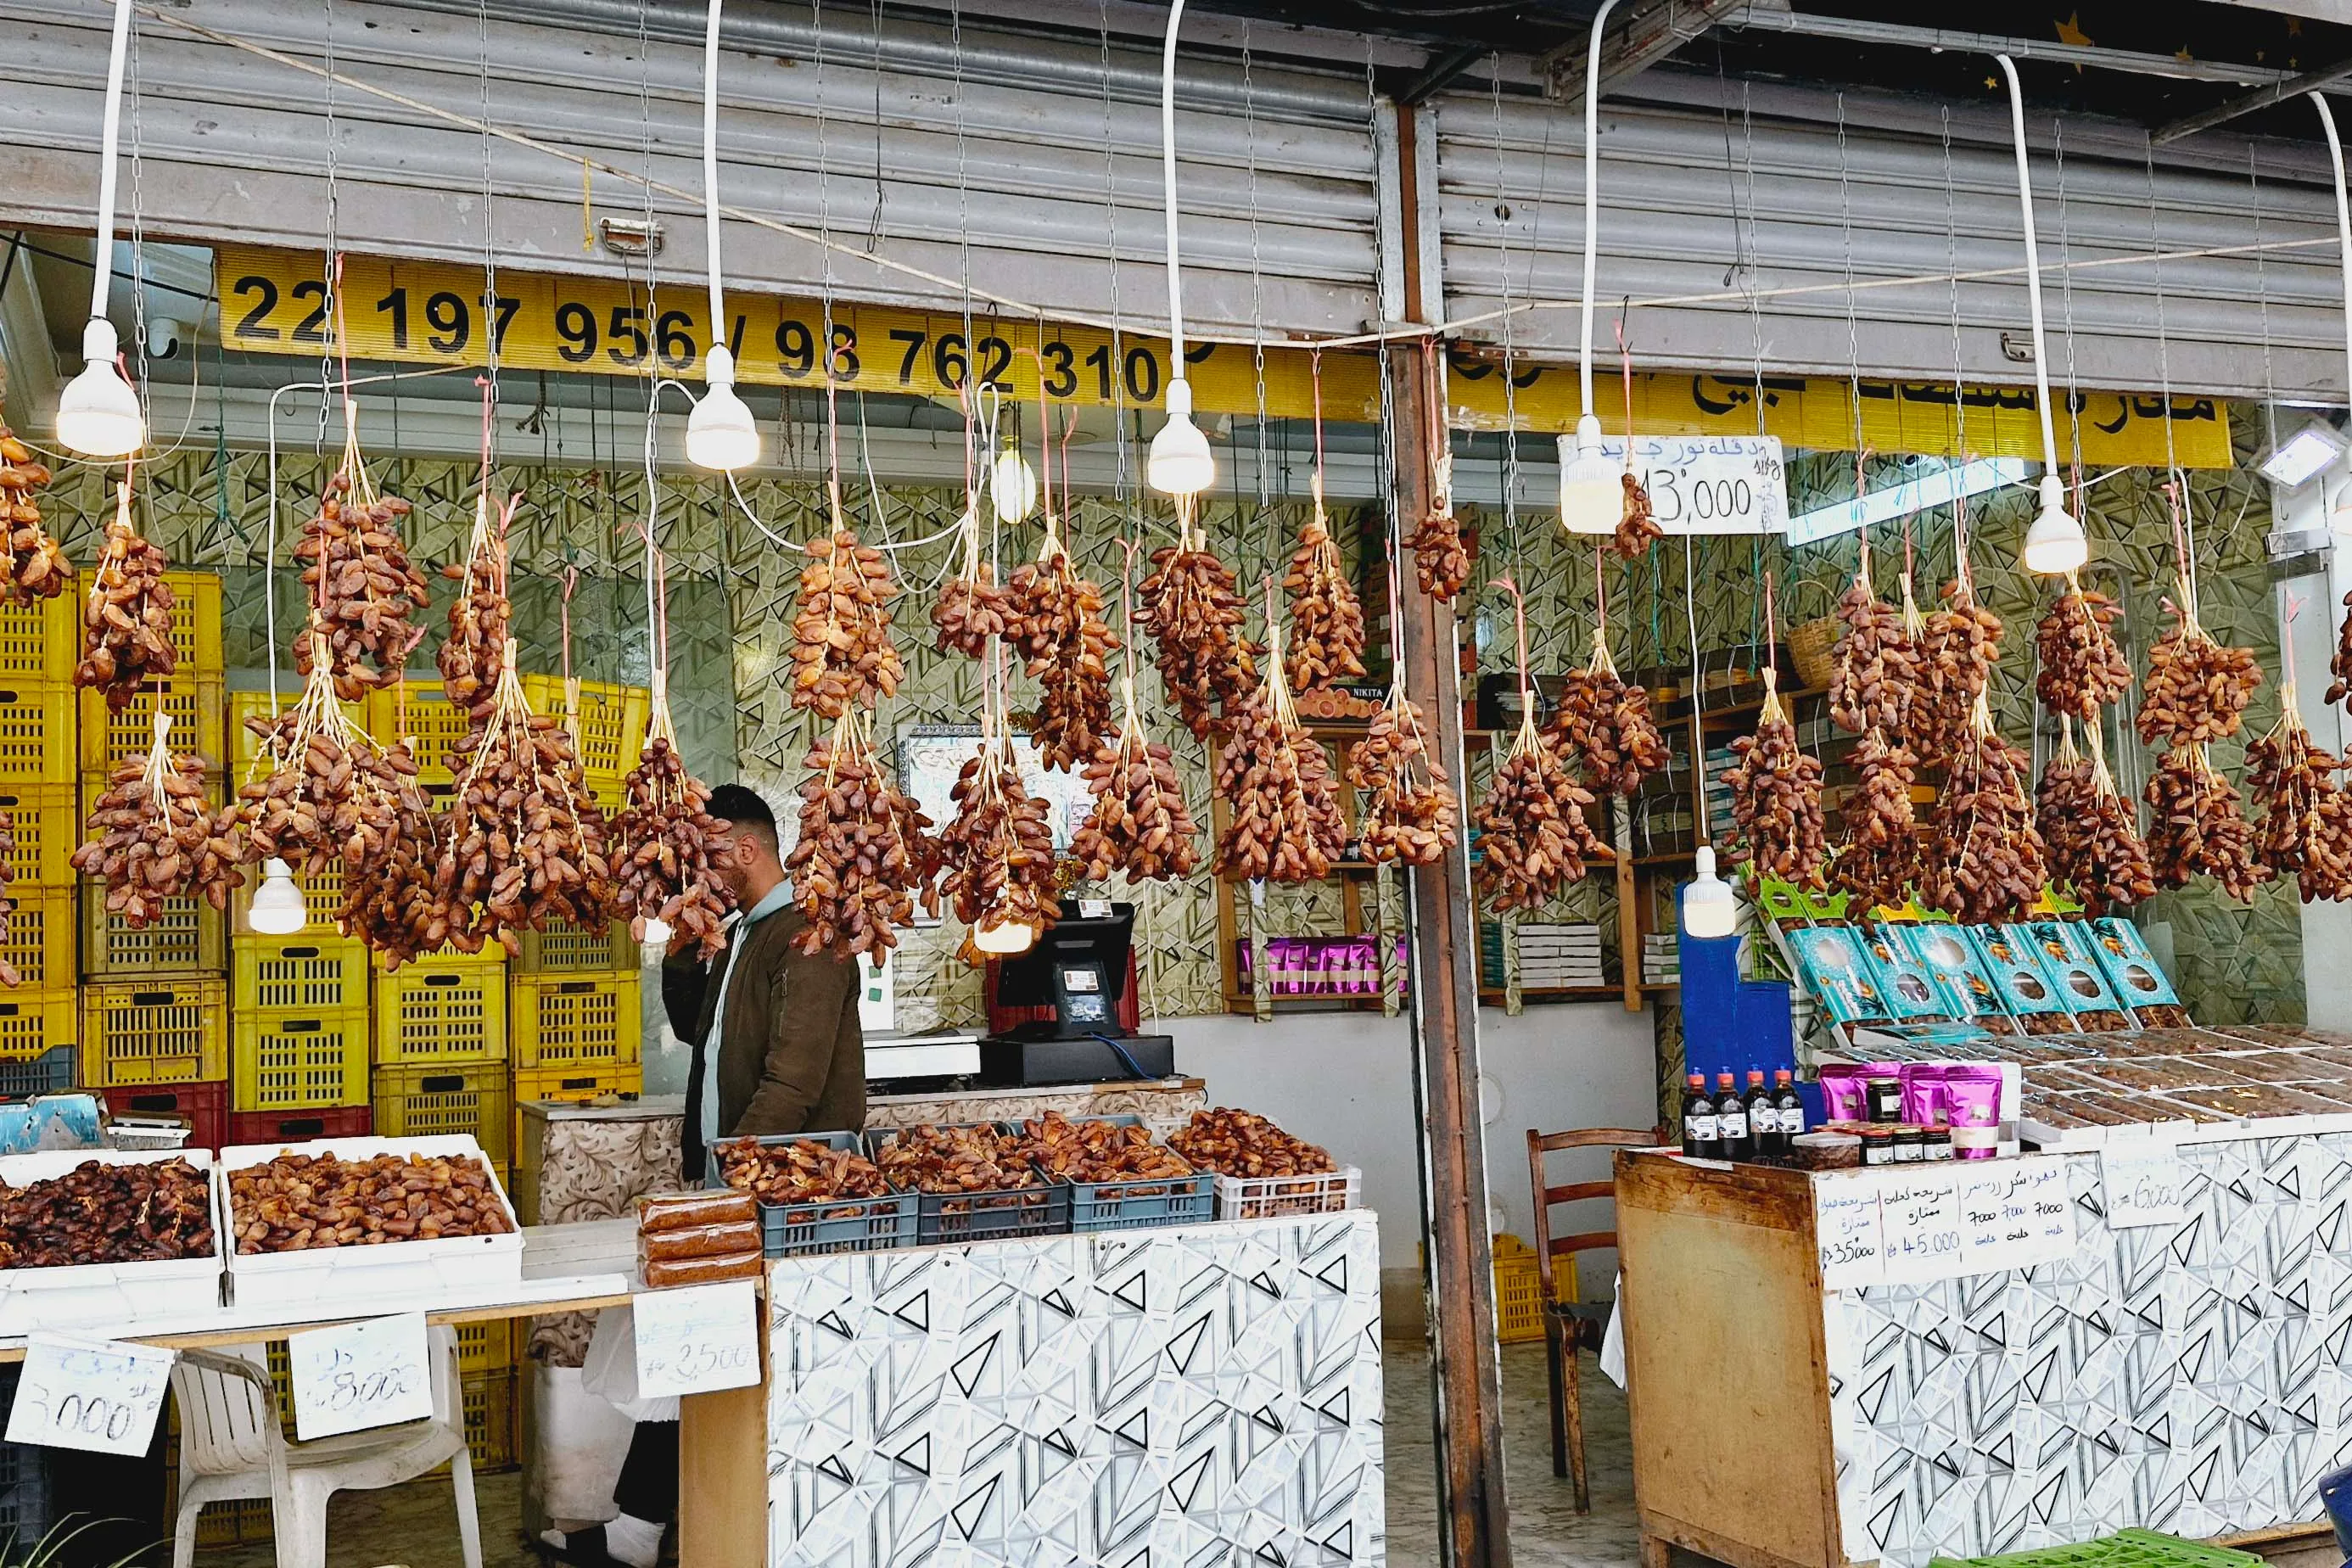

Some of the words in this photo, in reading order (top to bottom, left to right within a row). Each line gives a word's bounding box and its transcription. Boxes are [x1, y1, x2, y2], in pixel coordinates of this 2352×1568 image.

[233, 276, 336, 341] 22
[376, 287, 522, 354] 197
[555, 303, 697, 369] 956
[775, 319, 860, 383] 98
[888, 328, 1014, 389] 762
[1041, 340, 1159, 403] 310
[1353, 688, 1383, 697] NIKITA
